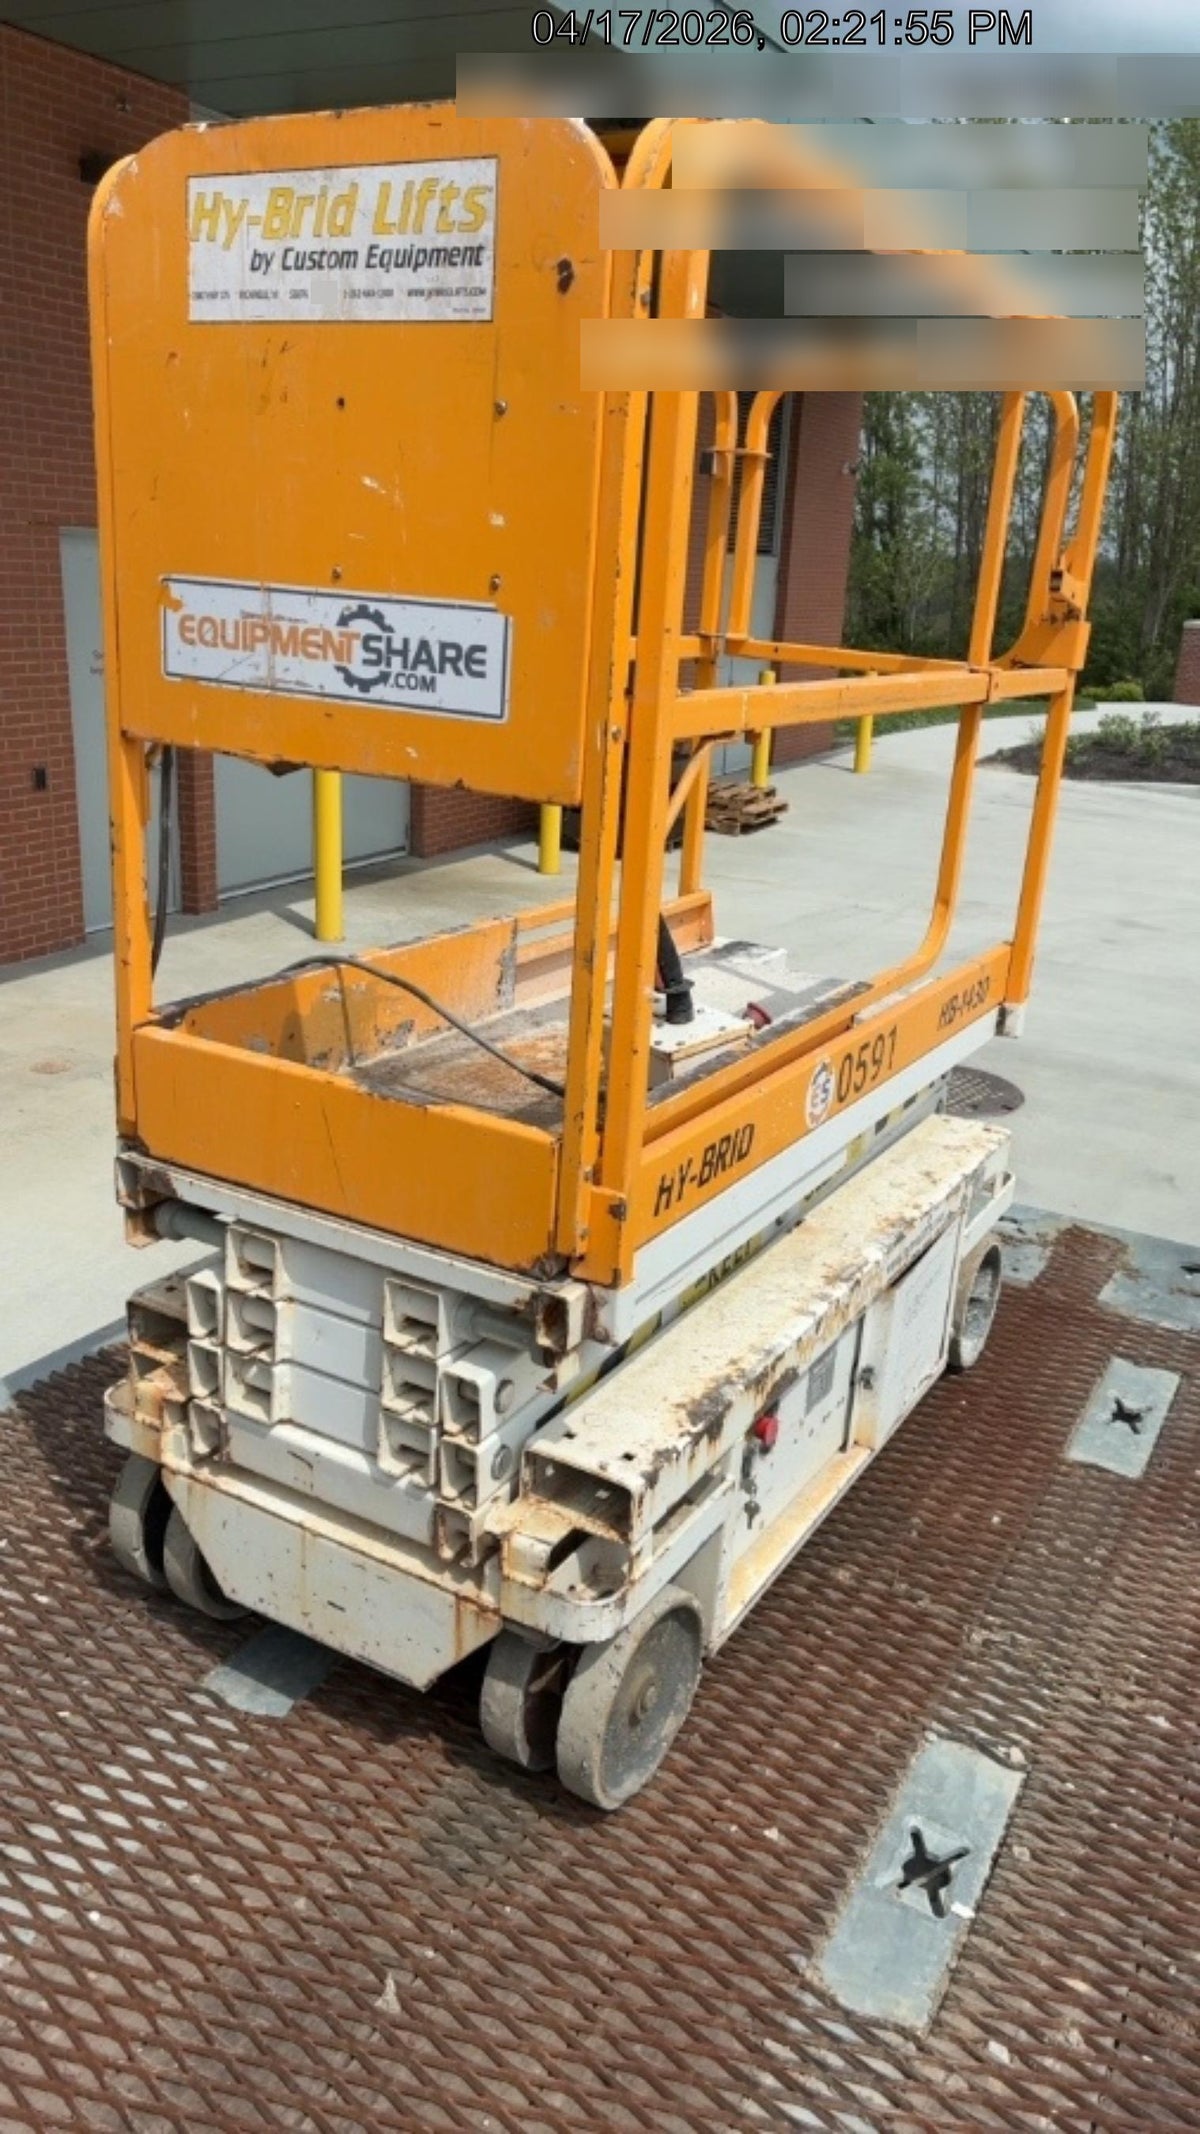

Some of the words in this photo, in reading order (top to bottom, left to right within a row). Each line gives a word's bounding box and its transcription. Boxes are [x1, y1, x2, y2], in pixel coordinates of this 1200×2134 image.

[190, 181, 359, 251] Hy-Brid
[372, 177, 489, 235] Lifts
[250, 248, 275, 275] by
[281, 246, 359, 271] Custom
[365, 243, 486, 273] Equipment
[837, 1025, 897, 1104] 0591
[653, 1123, 755, 1217] HY-BRID
